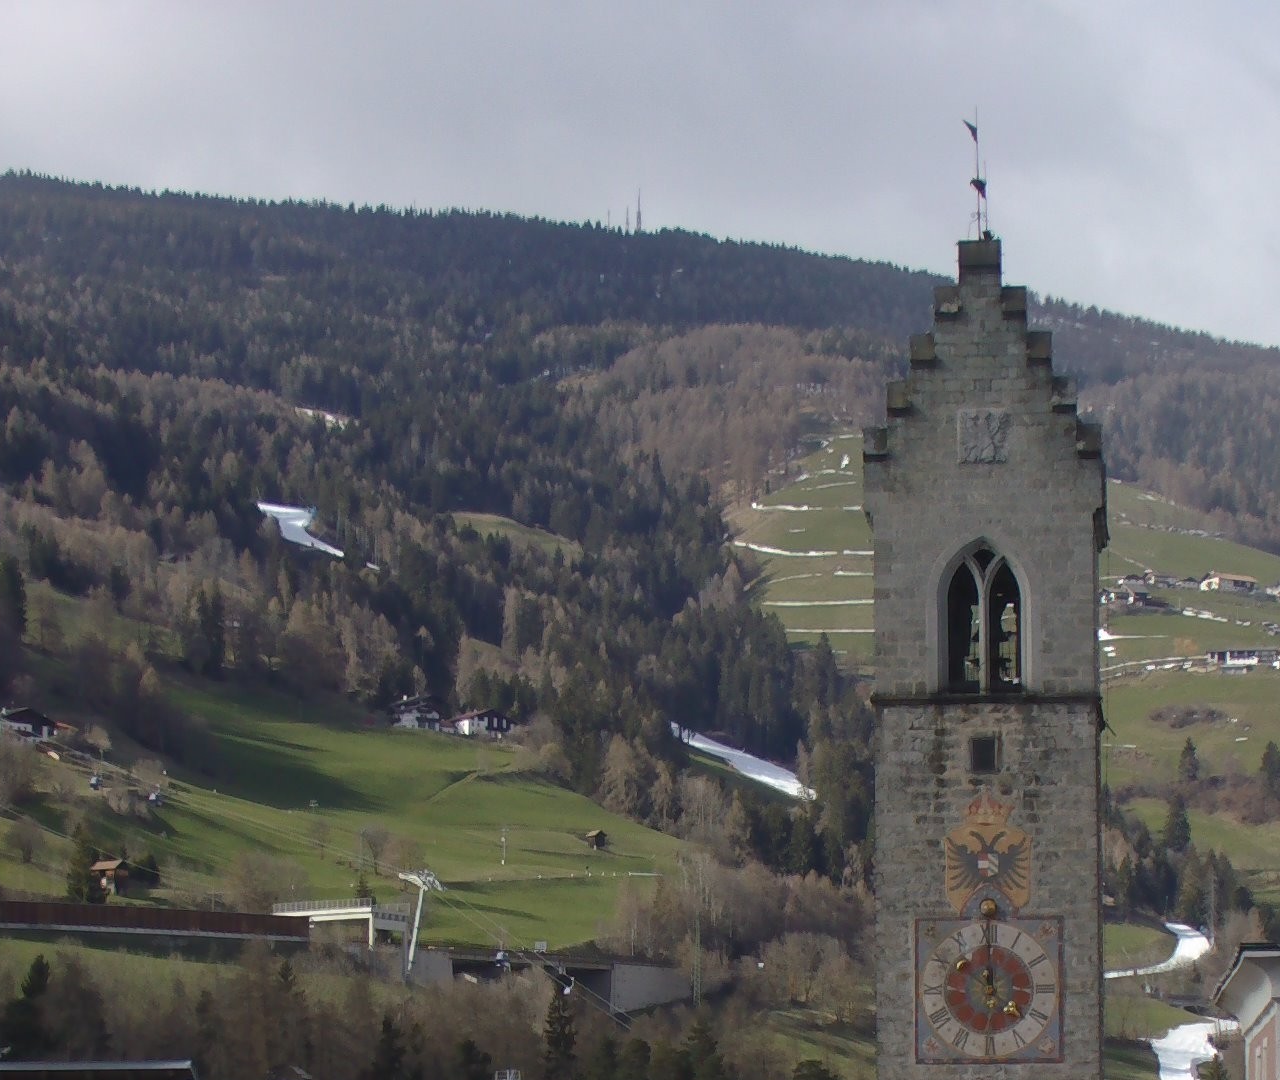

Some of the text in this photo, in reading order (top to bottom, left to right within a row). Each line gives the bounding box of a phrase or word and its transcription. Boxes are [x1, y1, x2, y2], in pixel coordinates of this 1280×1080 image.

[980, 924, 998, 944] XII
[1011, 932, 1022, 948] I
[1028, 953, 1047, 969] II
[924, 984, 942, 995] IX
[1036, 984, 1055, 994] III
[929, 1007, 951, 1029] VIII
[1029, 1008, 1048, 1027] IV
[952, 1028, 969, 1050] VII
[985, 1035, 996, 1055] VI
[1013, 1029, 1026, 1048] V
